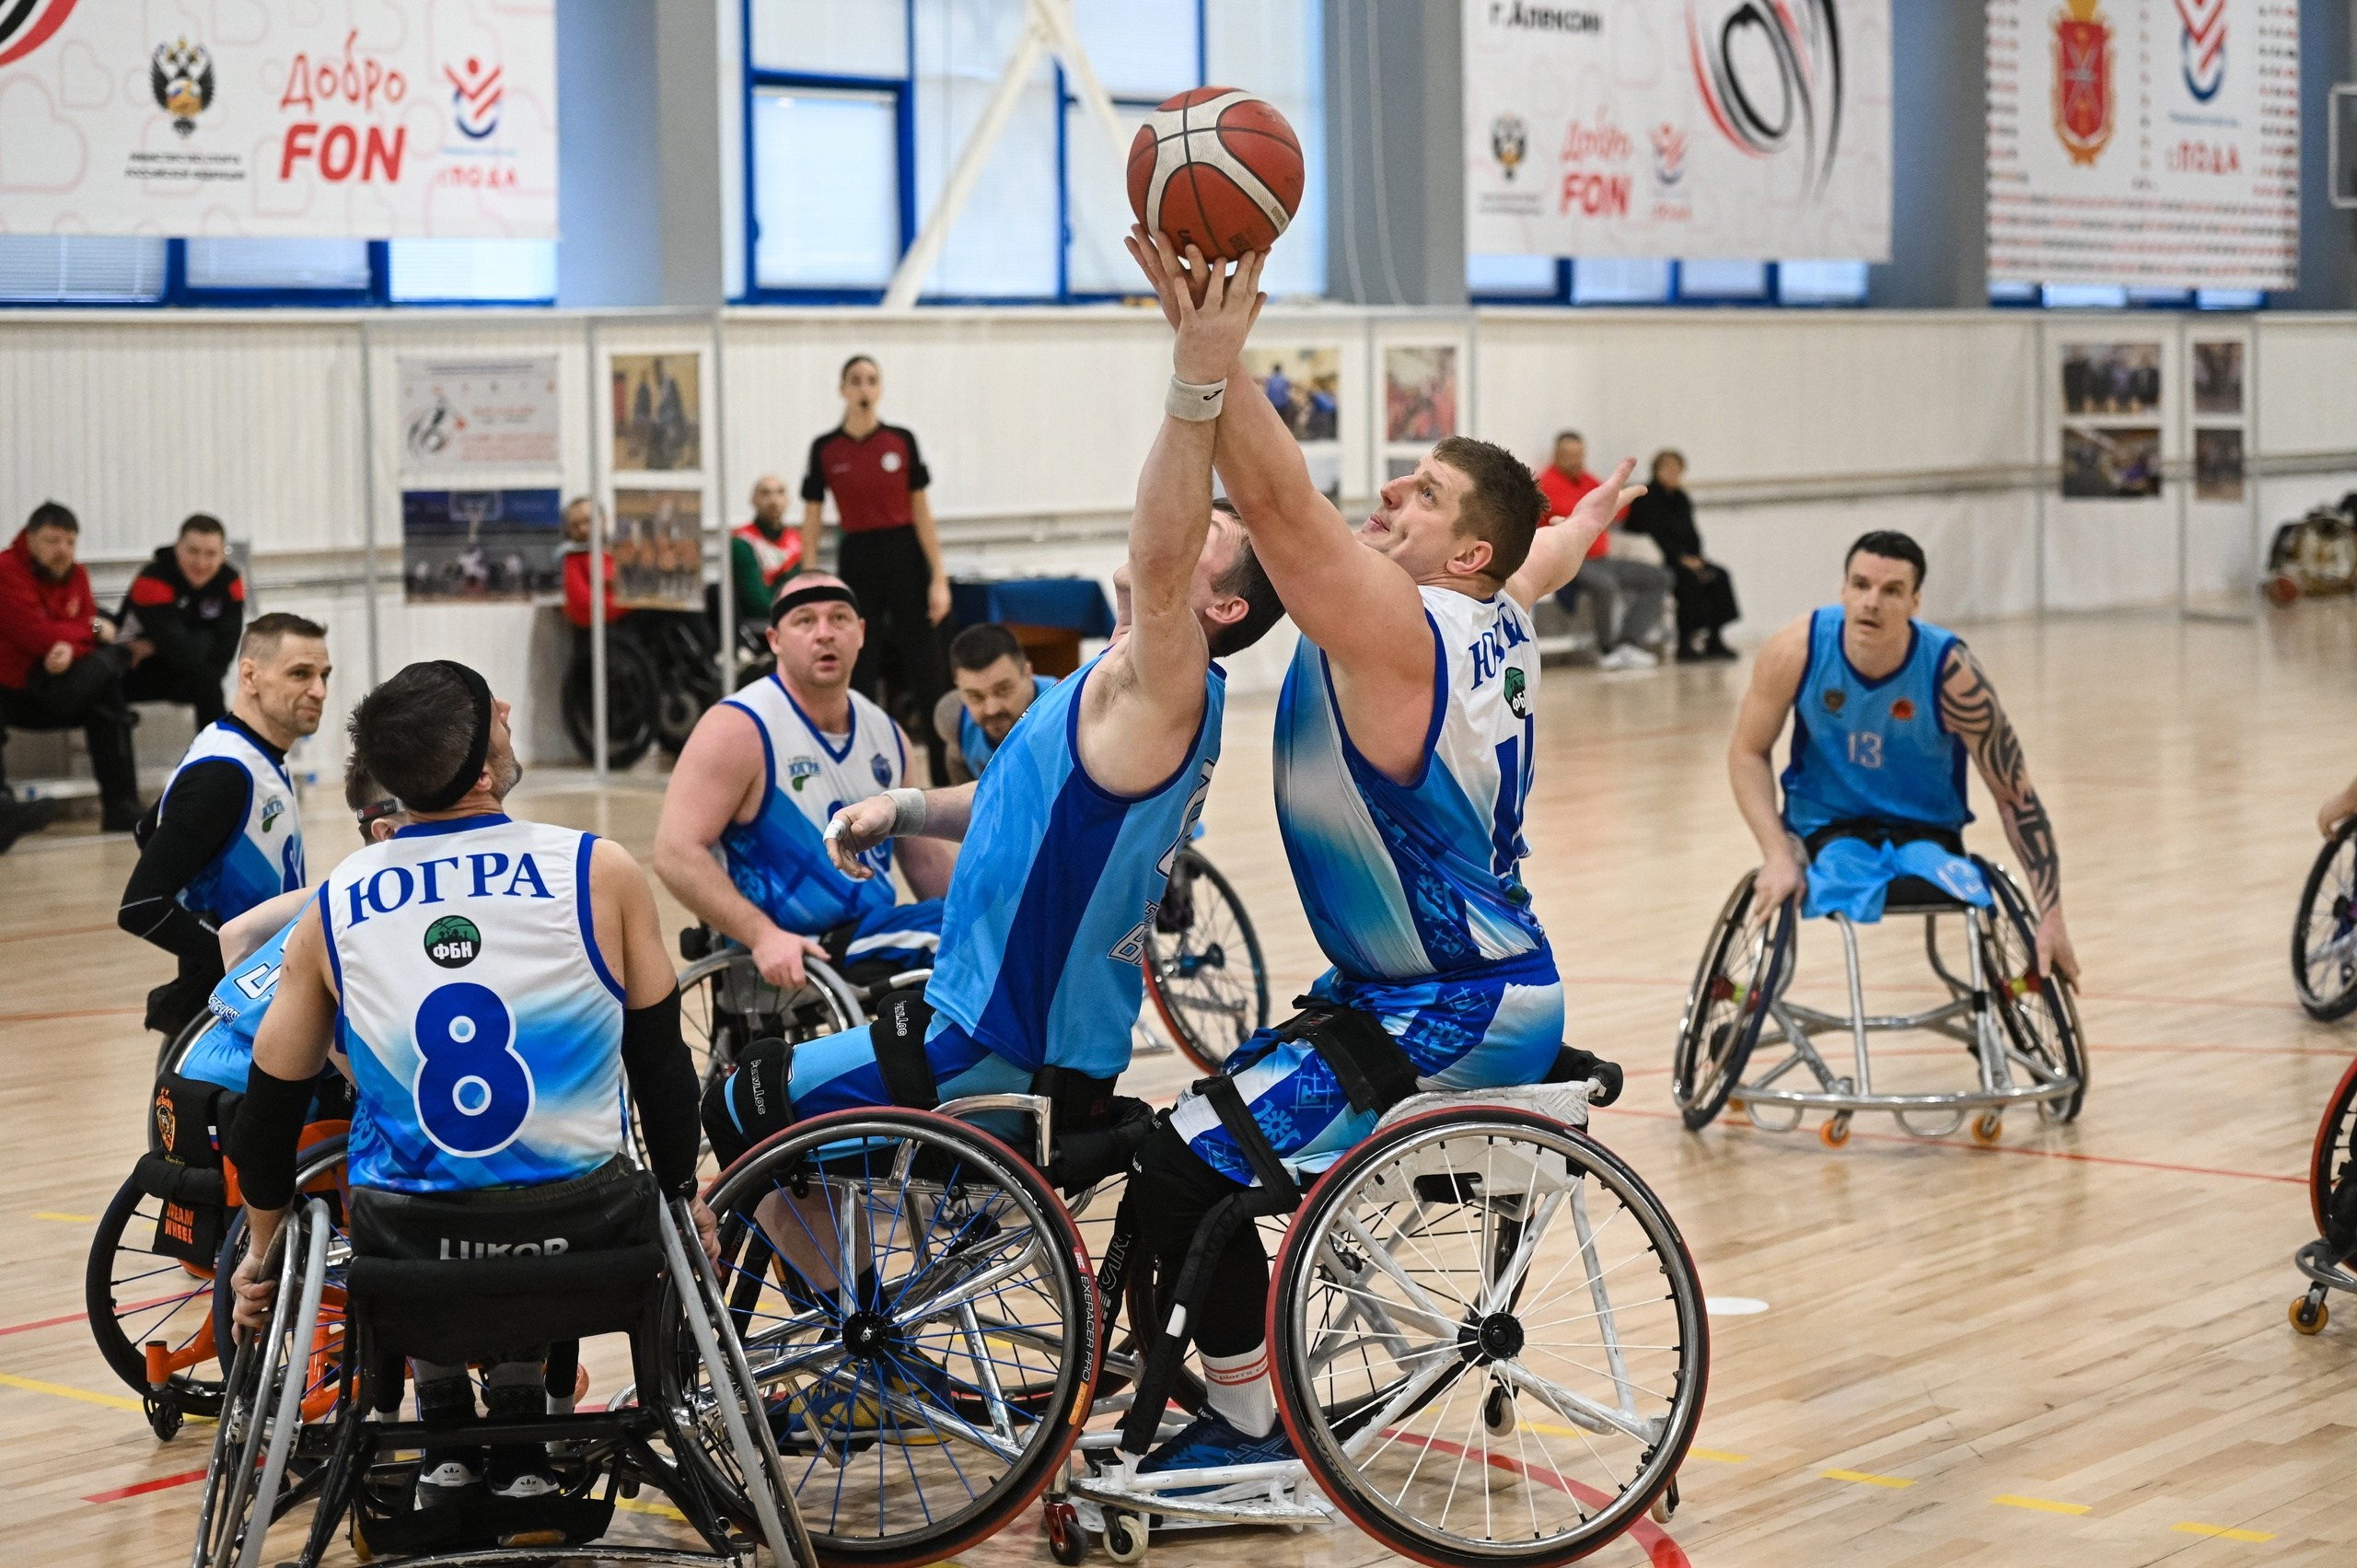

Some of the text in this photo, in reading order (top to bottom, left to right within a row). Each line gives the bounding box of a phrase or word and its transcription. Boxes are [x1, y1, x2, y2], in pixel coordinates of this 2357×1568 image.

[281, 29, 406, 113] Добро
[280, 124, 405, 182] FON
[1560, 174, 1633, 217] FON
[1848, 731, 1884, 769] 13
[344, 853, 555, 928] ЮГРА
[1936, 860, 1983, 901] 13
[433, 941, 472, 960] ФБН
[413, 981, 535, 1157] 8
[165, 1218, 193, 1245] WHEEL
[1080, 1276, 1095, 1382] EXERACER PRO
